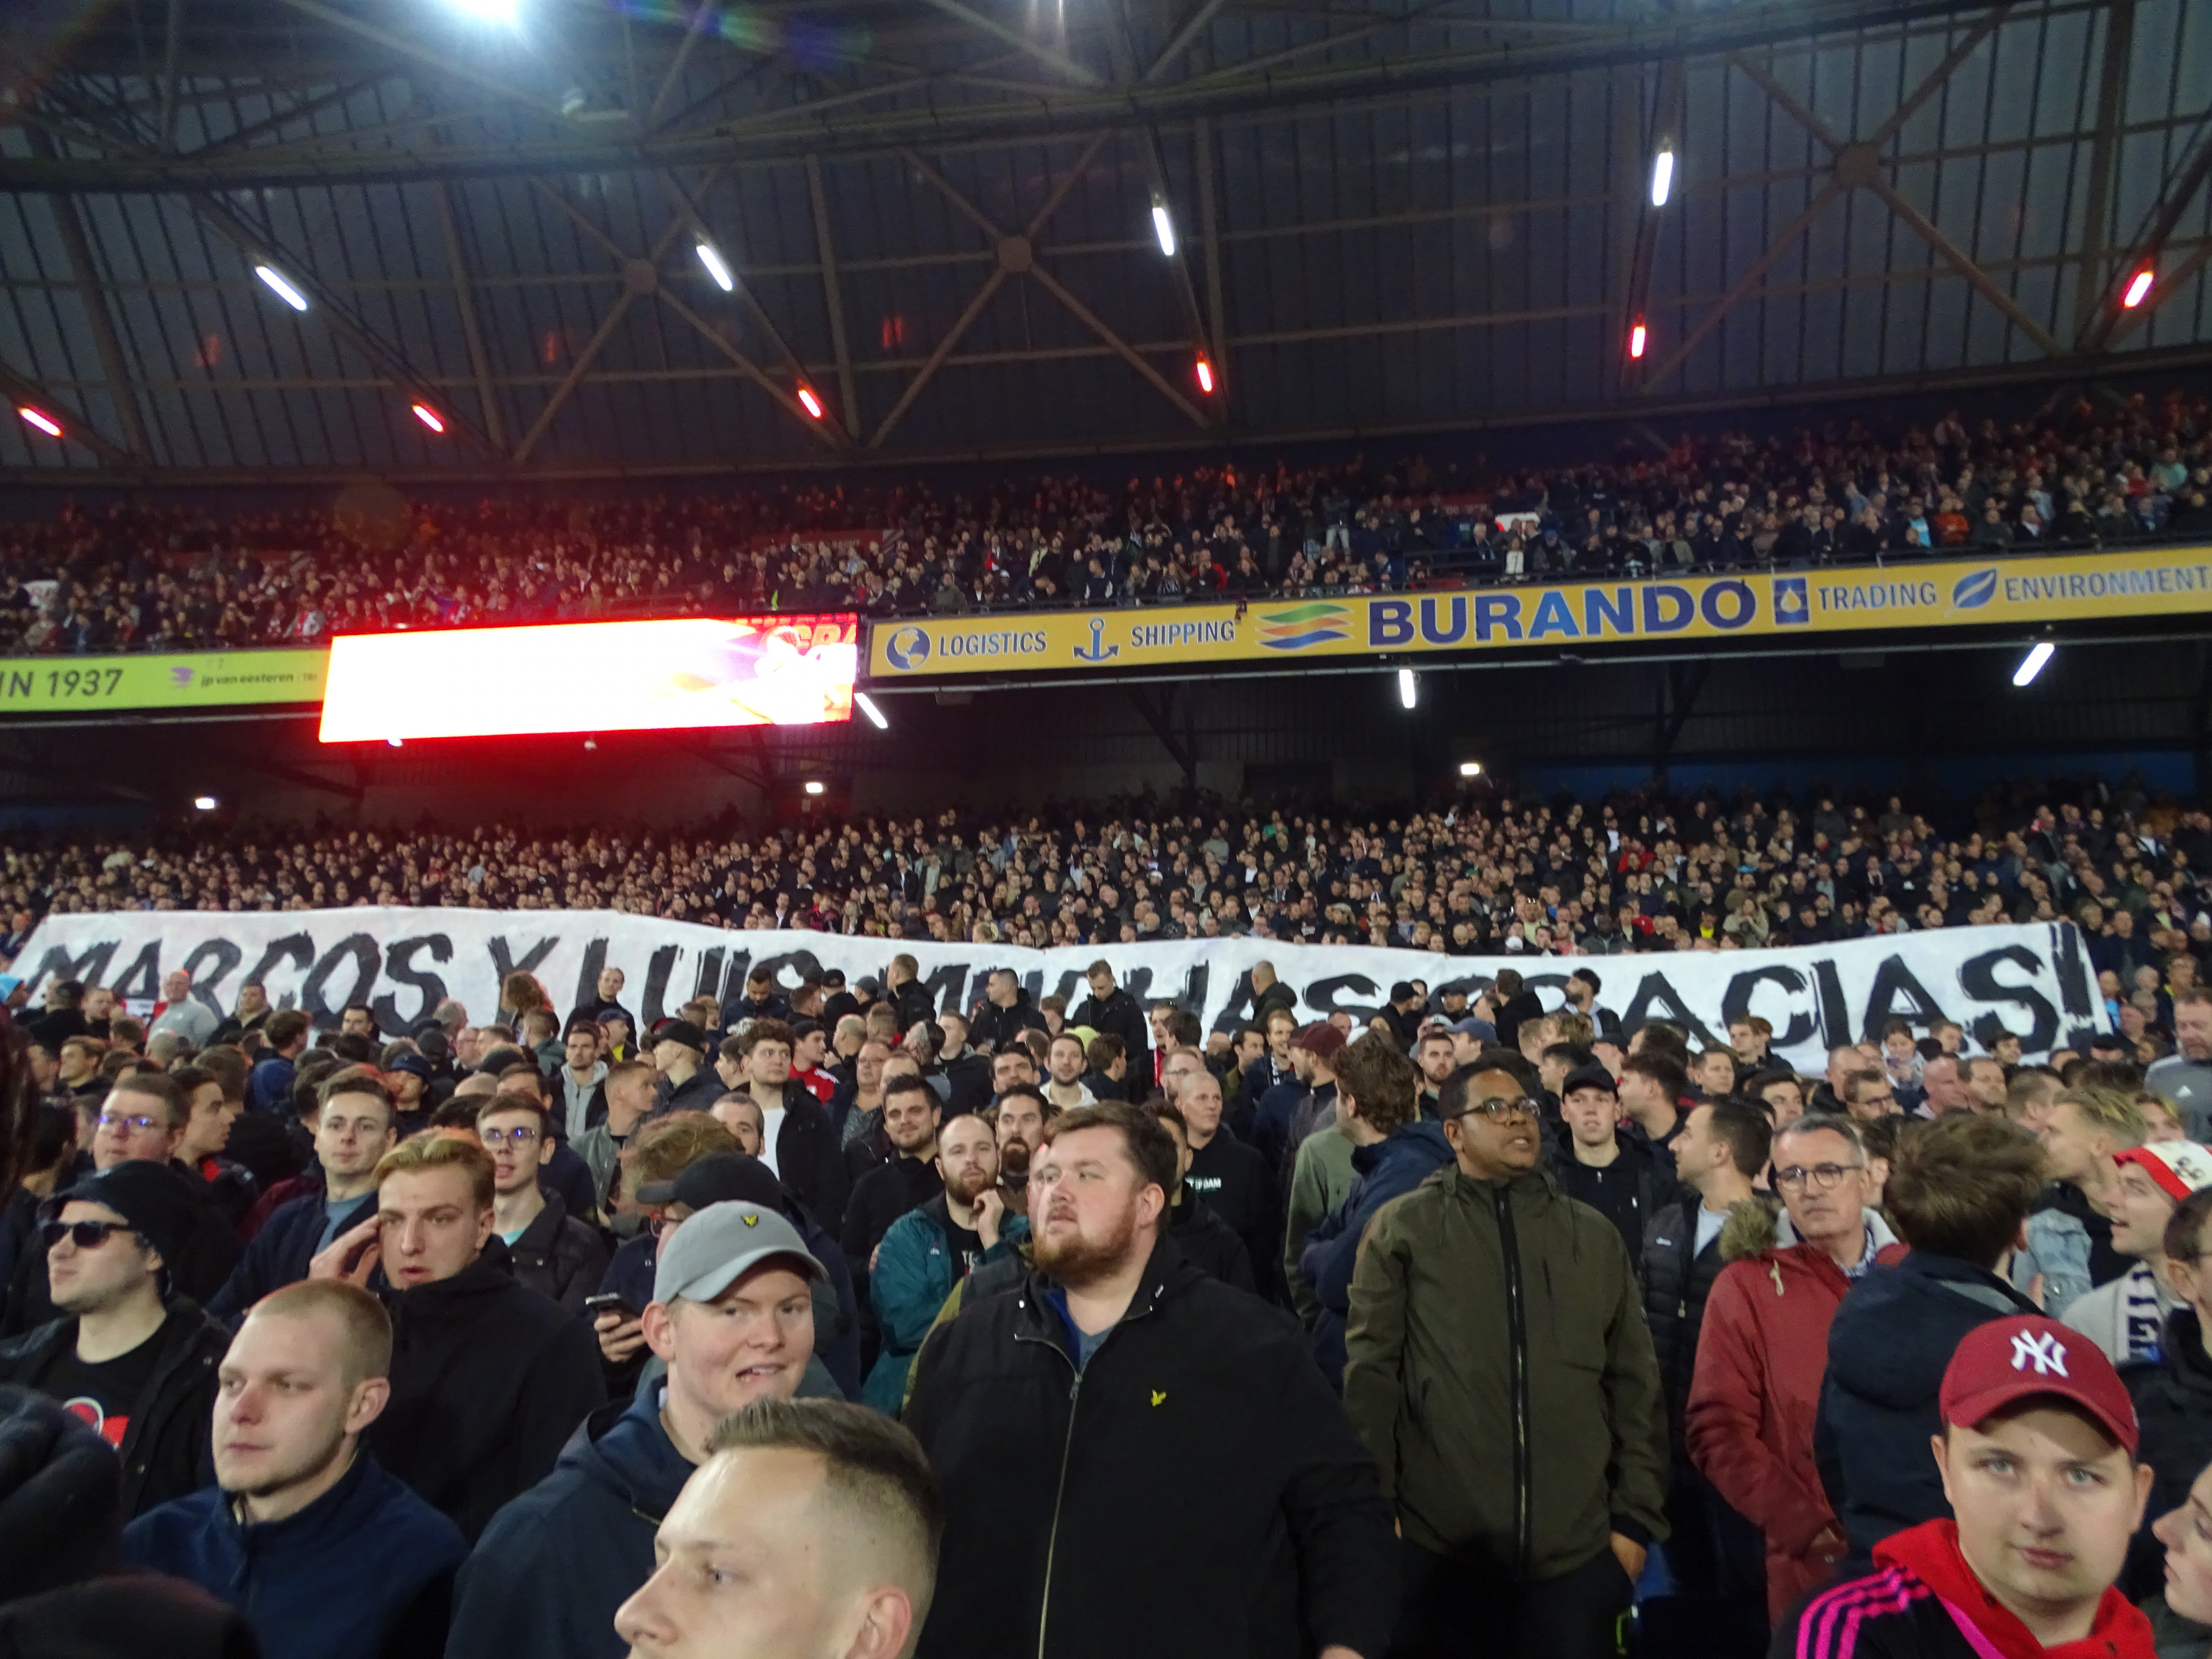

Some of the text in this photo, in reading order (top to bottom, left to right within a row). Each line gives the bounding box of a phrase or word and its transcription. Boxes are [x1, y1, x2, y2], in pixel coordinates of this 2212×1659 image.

[1818, 582, 1937, 611] TRADING
[2005, 564, 2212, 602] ENVIRONMENT
[1368, 580, 1756, 647] BURANDO
[939, 631, 1047, 657] LOGISTICS
[1130, 619, 1236, 647] SHIPPING
[48, 668, 123, 698] 1937
[216, 676, 237, 684] van
[23, 930, 453, 1037] MARCOS
